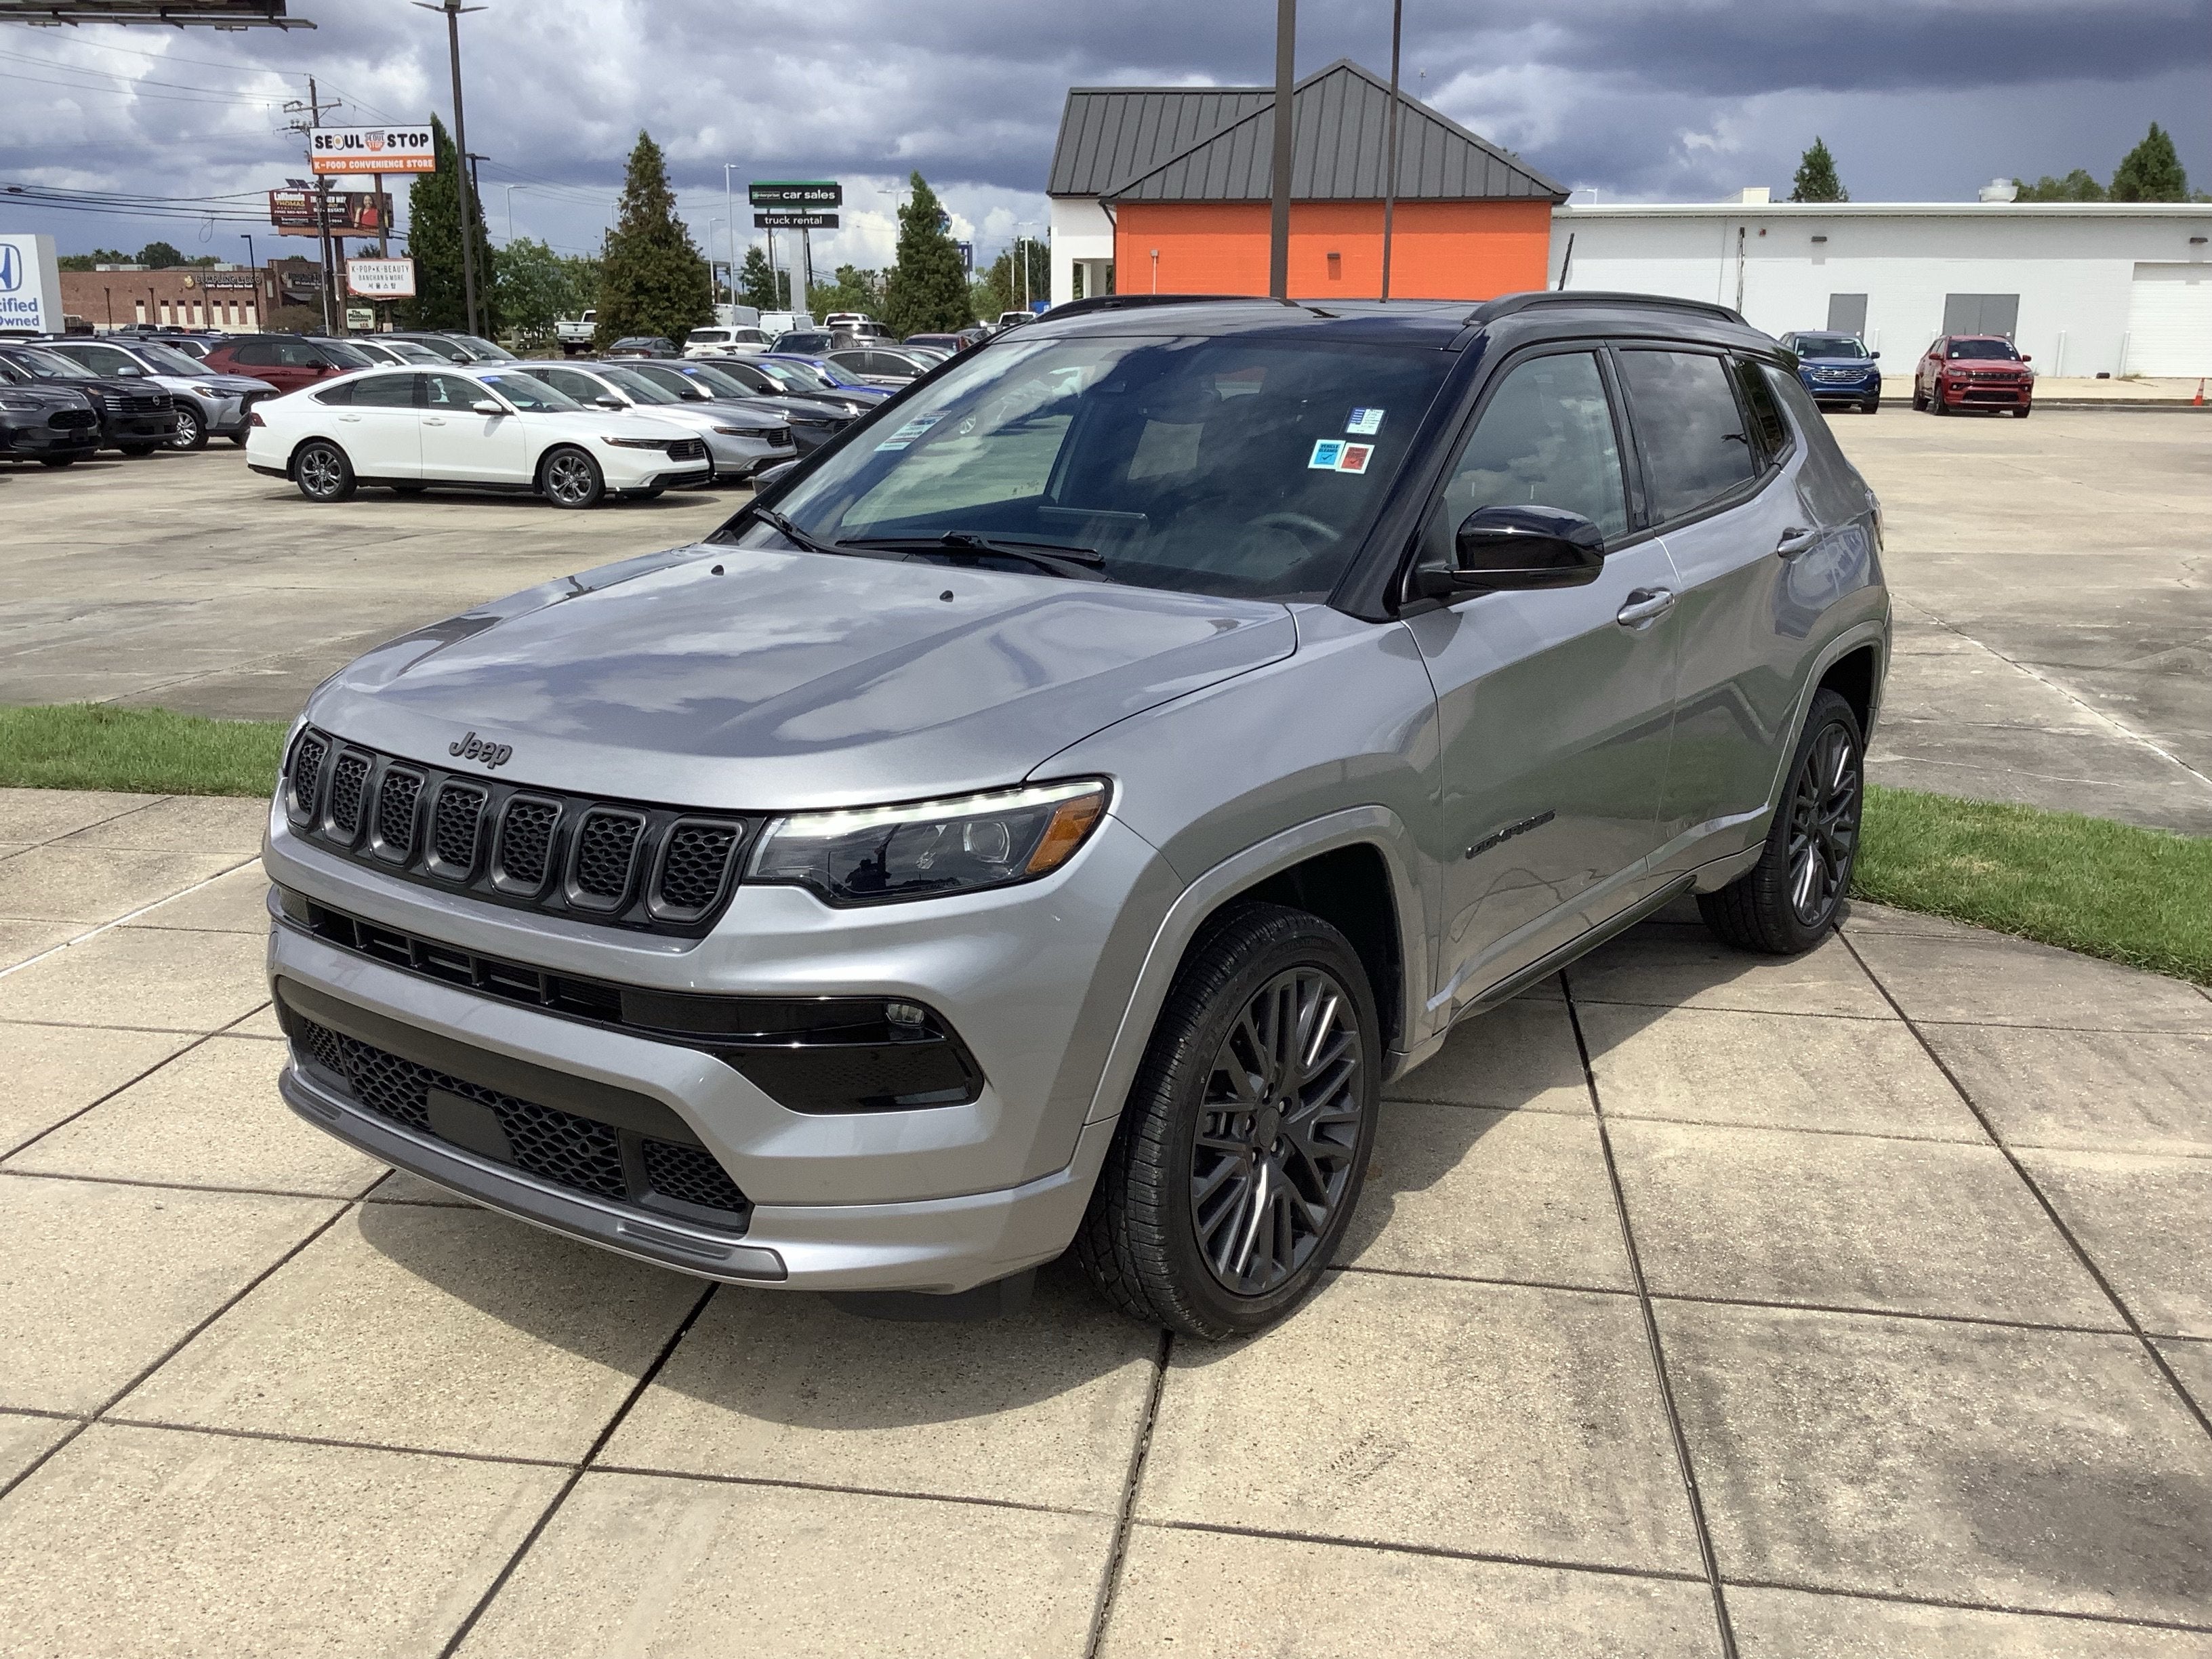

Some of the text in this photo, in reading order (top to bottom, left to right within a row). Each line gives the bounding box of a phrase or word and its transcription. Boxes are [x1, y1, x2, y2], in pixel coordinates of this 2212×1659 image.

[315, 134, 429, 150] SEOUL STOP
[314, 159, 433, 169] K-FOOD CONVENIENCE STORE
[804, 189, 836, 199] sales
[764, 216, 823, 224] truck rental
[449, 731, 513, 770] Jeep
